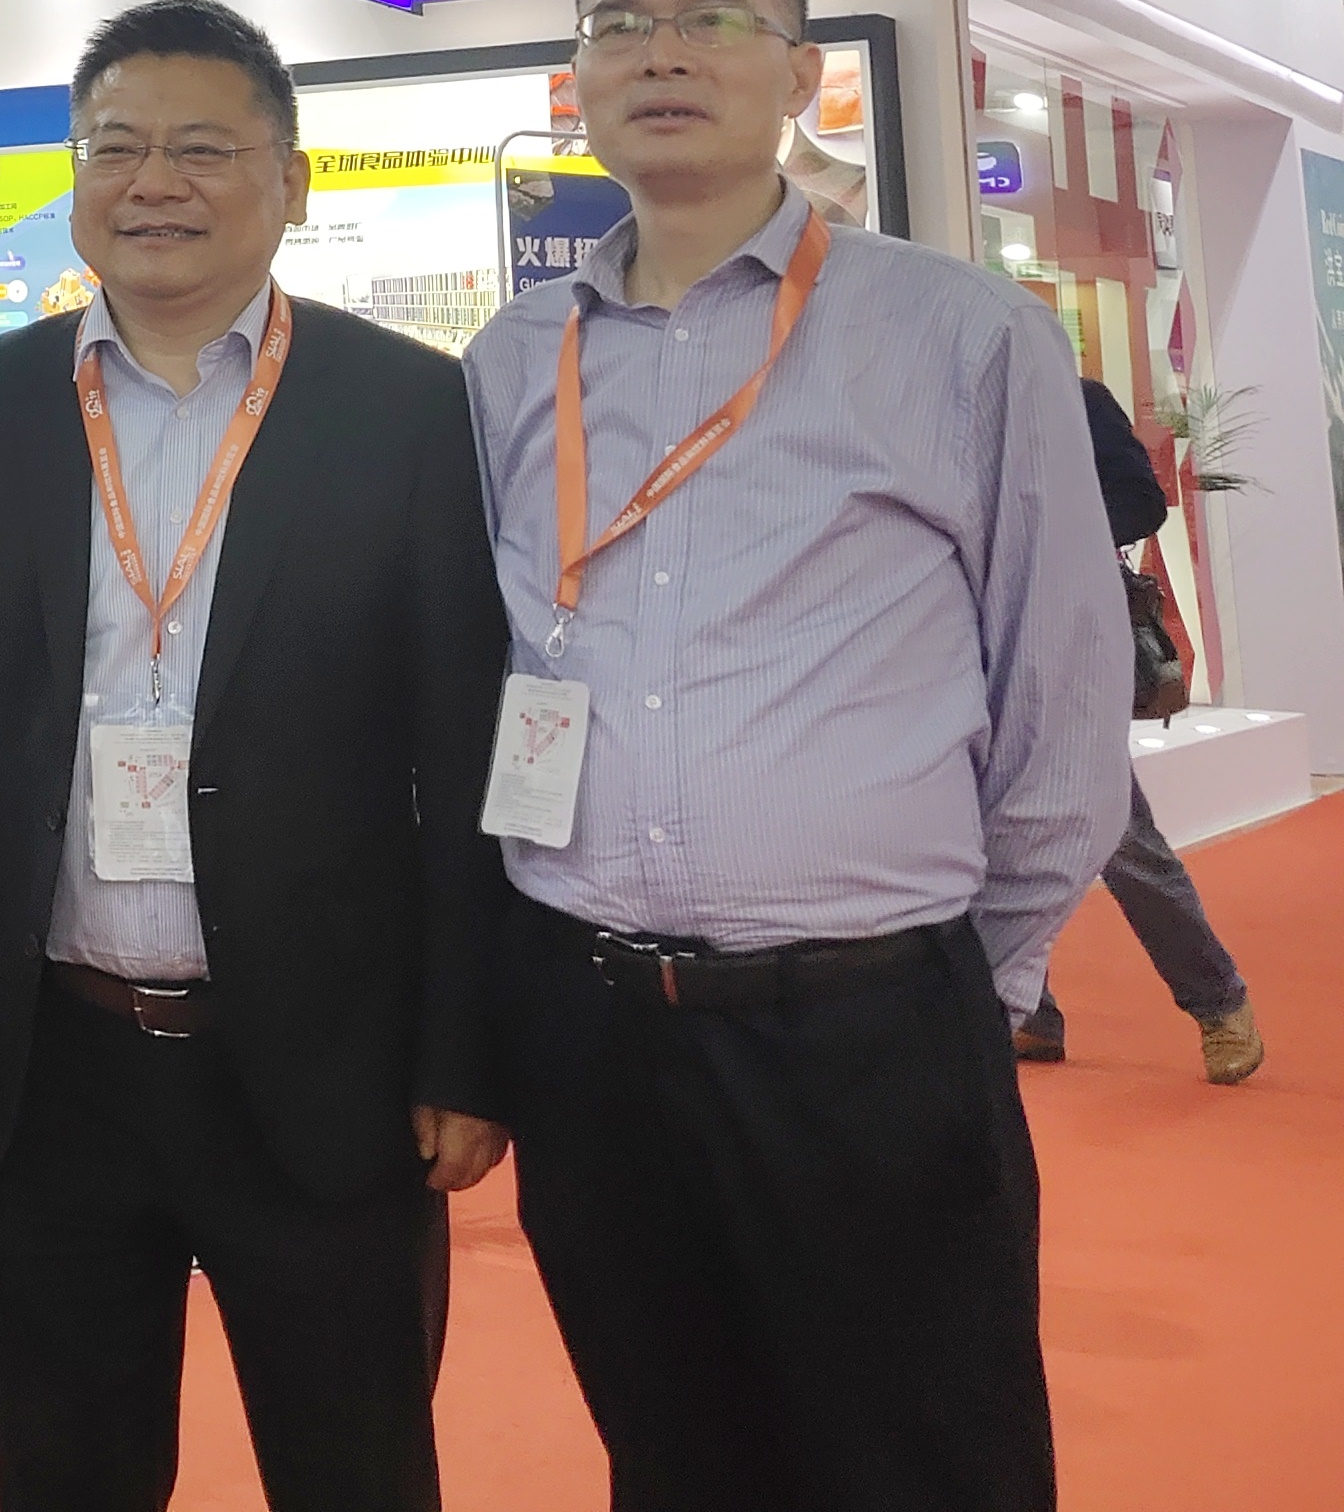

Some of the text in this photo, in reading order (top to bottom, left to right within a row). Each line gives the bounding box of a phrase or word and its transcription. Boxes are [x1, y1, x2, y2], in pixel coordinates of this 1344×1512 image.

[314, 144, 497, 175] 全球食品体验中心
